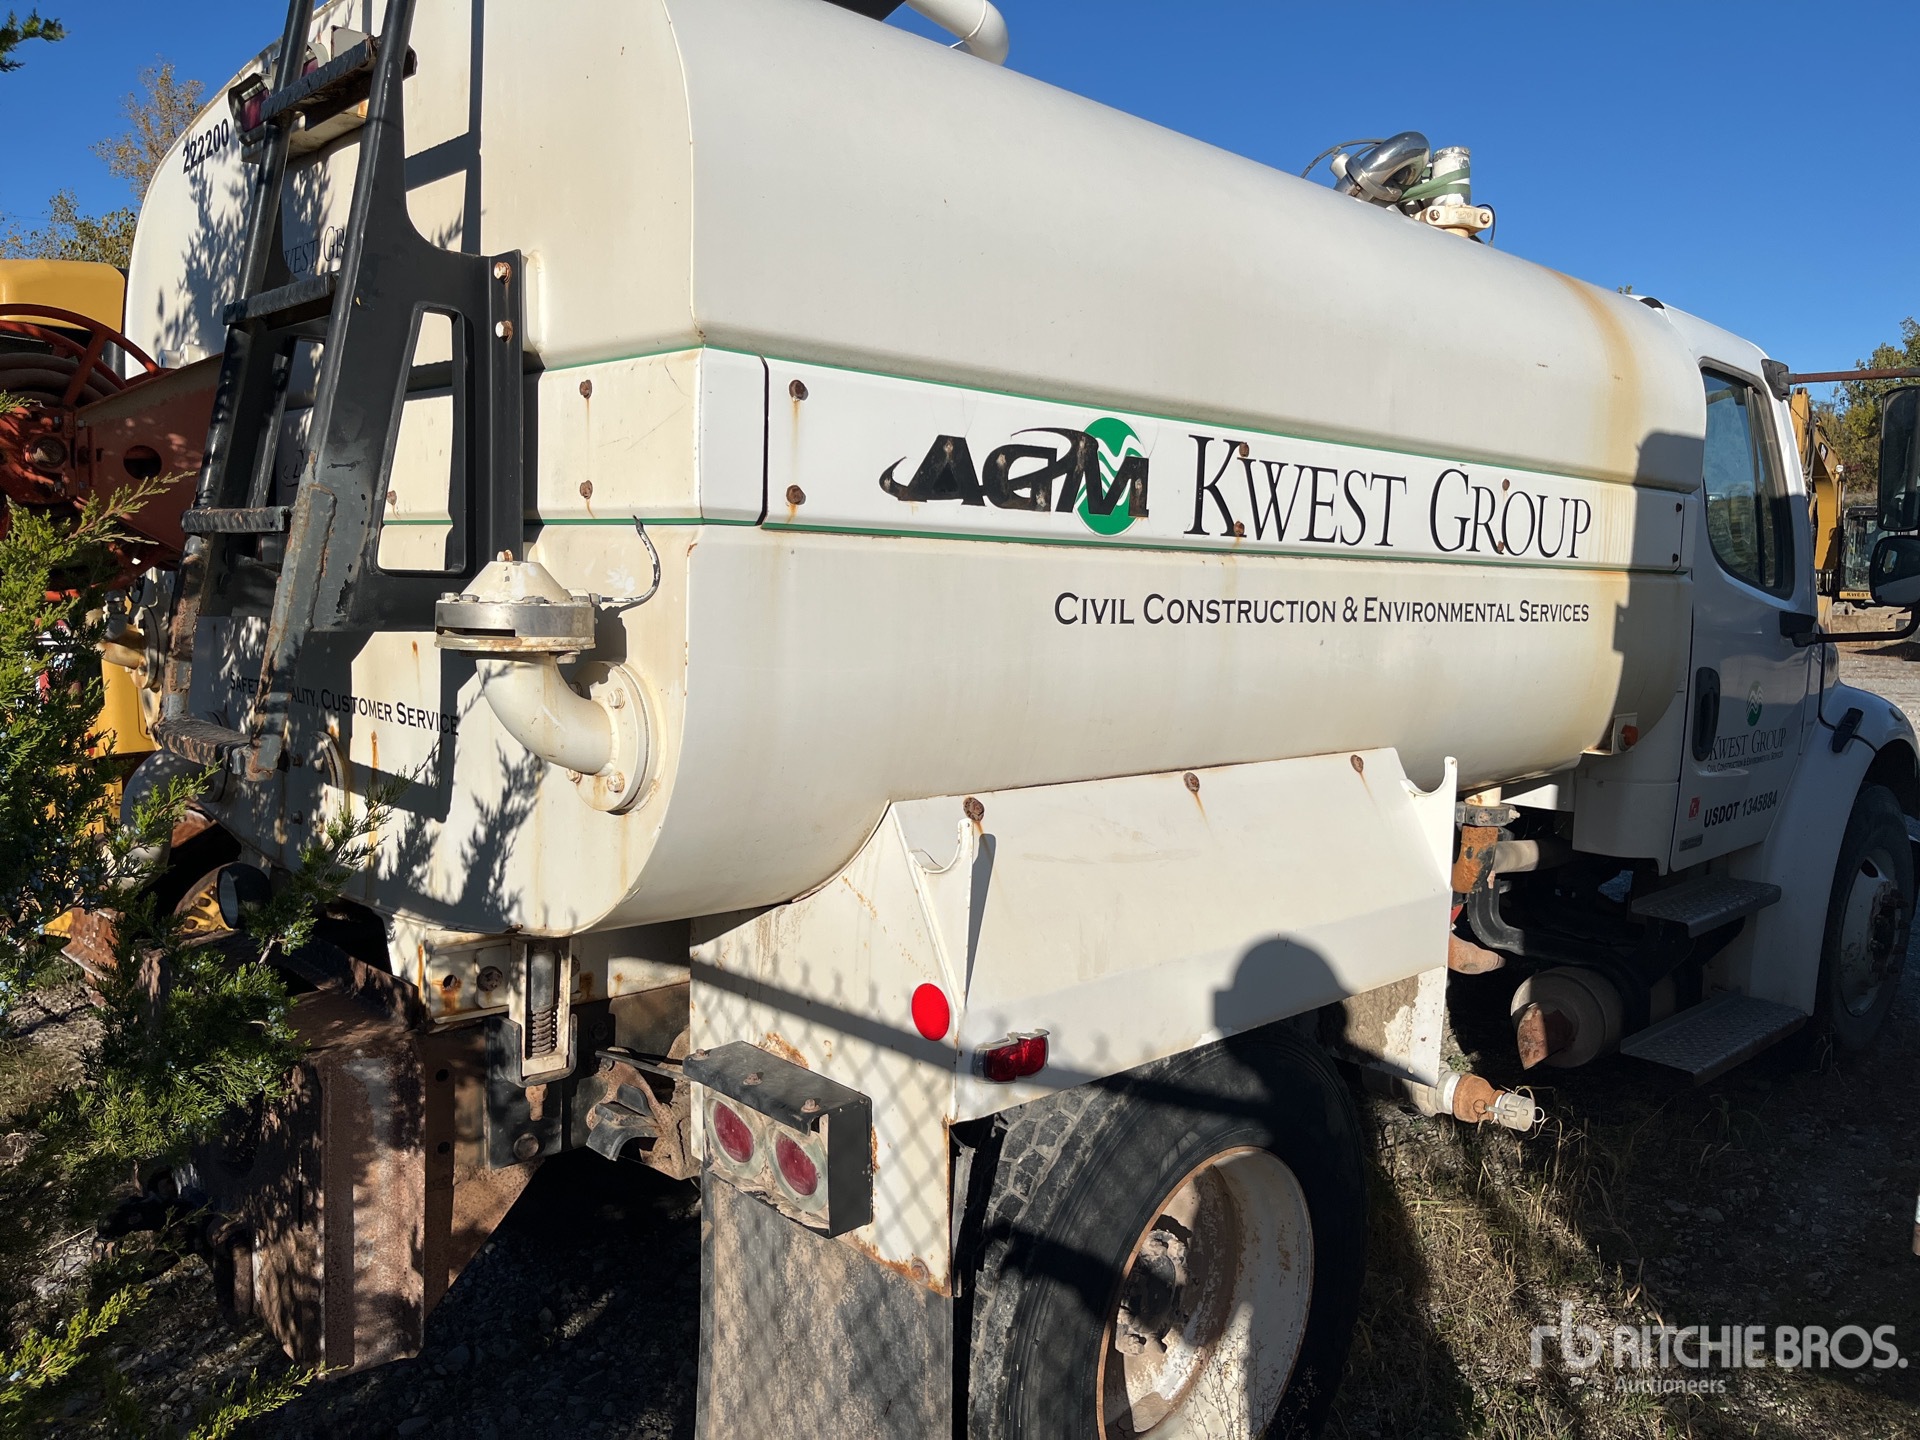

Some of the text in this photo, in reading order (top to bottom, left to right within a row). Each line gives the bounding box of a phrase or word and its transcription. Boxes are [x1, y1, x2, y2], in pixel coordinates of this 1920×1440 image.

[183, 118, 229, 174] 222200
[879, 427, 1149, 517] AGM
[1184, 434, 1591, 559] KWEST GROUP
[1054, 592, 1589, 625] CIVIL CONSTRUCTION & ENVIRONMENTAL SERVICES
[230, 671, 259, 694] SAFET
[321, 688, 393, 723] CUSTOMER
[397, 702, 459, 736] SERVICE
[1709, 728, 1786, 761] KWEST GROUP
[1704, 790, 1778, 828] USDOT 1345884
